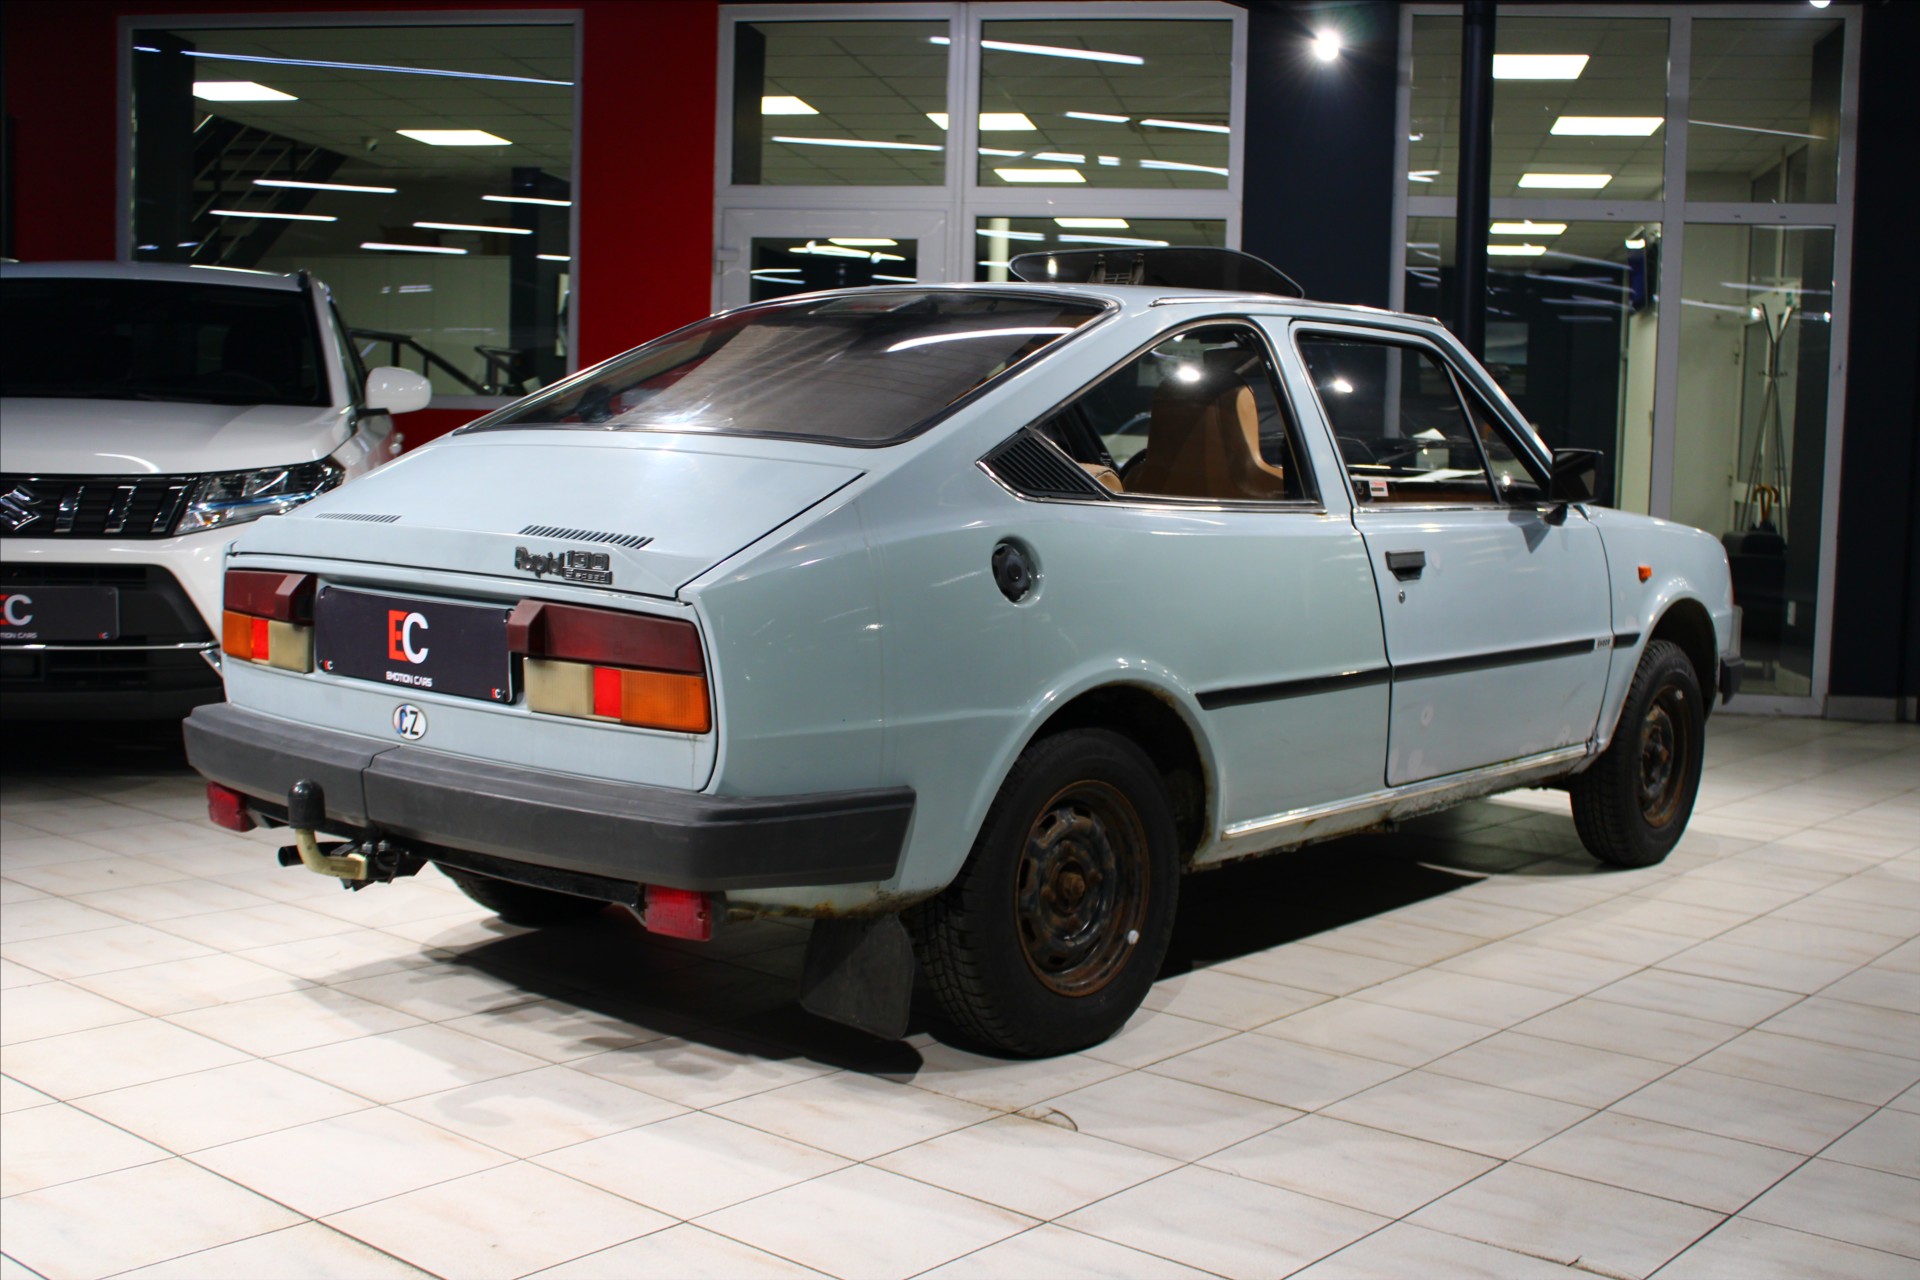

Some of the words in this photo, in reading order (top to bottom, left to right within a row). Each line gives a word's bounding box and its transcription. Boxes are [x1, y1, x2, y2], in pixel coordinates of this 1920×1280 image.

[514, 546, 565, 579] Rapid
[566, 550, 610, 572] 130
[388, 609, 429, 665] EC
[385, 671, 414, 685] EMOTION
[413, 675, 433, 688] CARS
[399, 708, 419, 736] CZ
